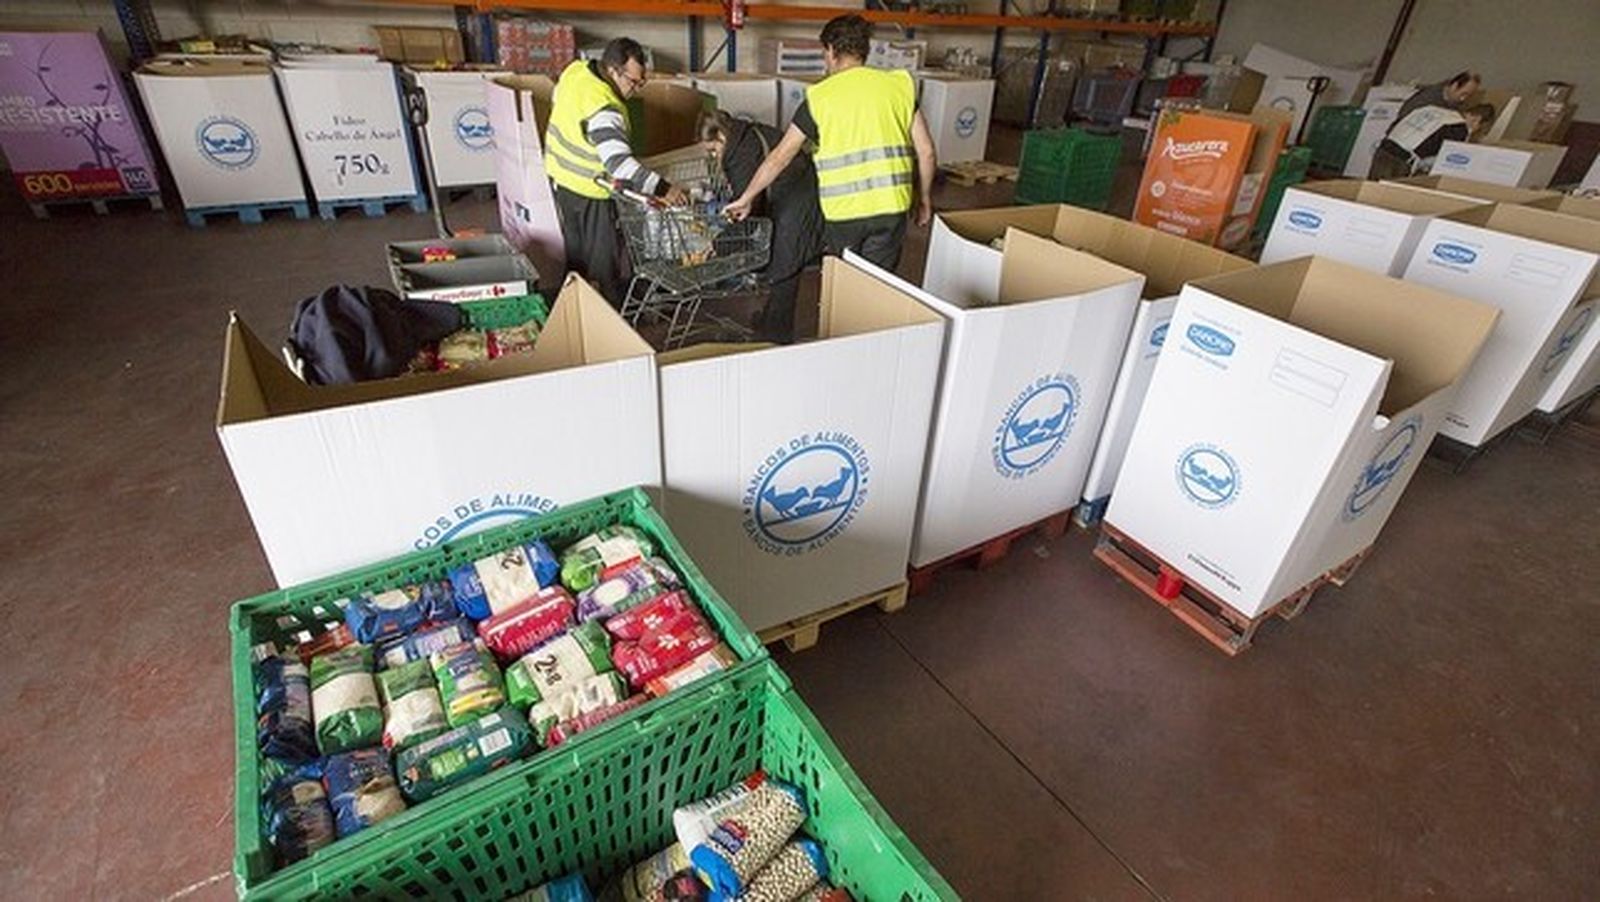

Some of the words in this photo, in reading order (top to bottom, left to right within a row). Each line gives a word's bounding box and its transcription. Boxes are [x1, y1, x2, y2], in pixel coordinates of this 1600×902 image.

[24, 173, 73, 195] 600
[743, 447, 786, 505] BANCOS
[790, 434, 811, 450] DE
[814, 431, 871, 476] ALIMENTOS
[454, 499, 485, 520] DE
